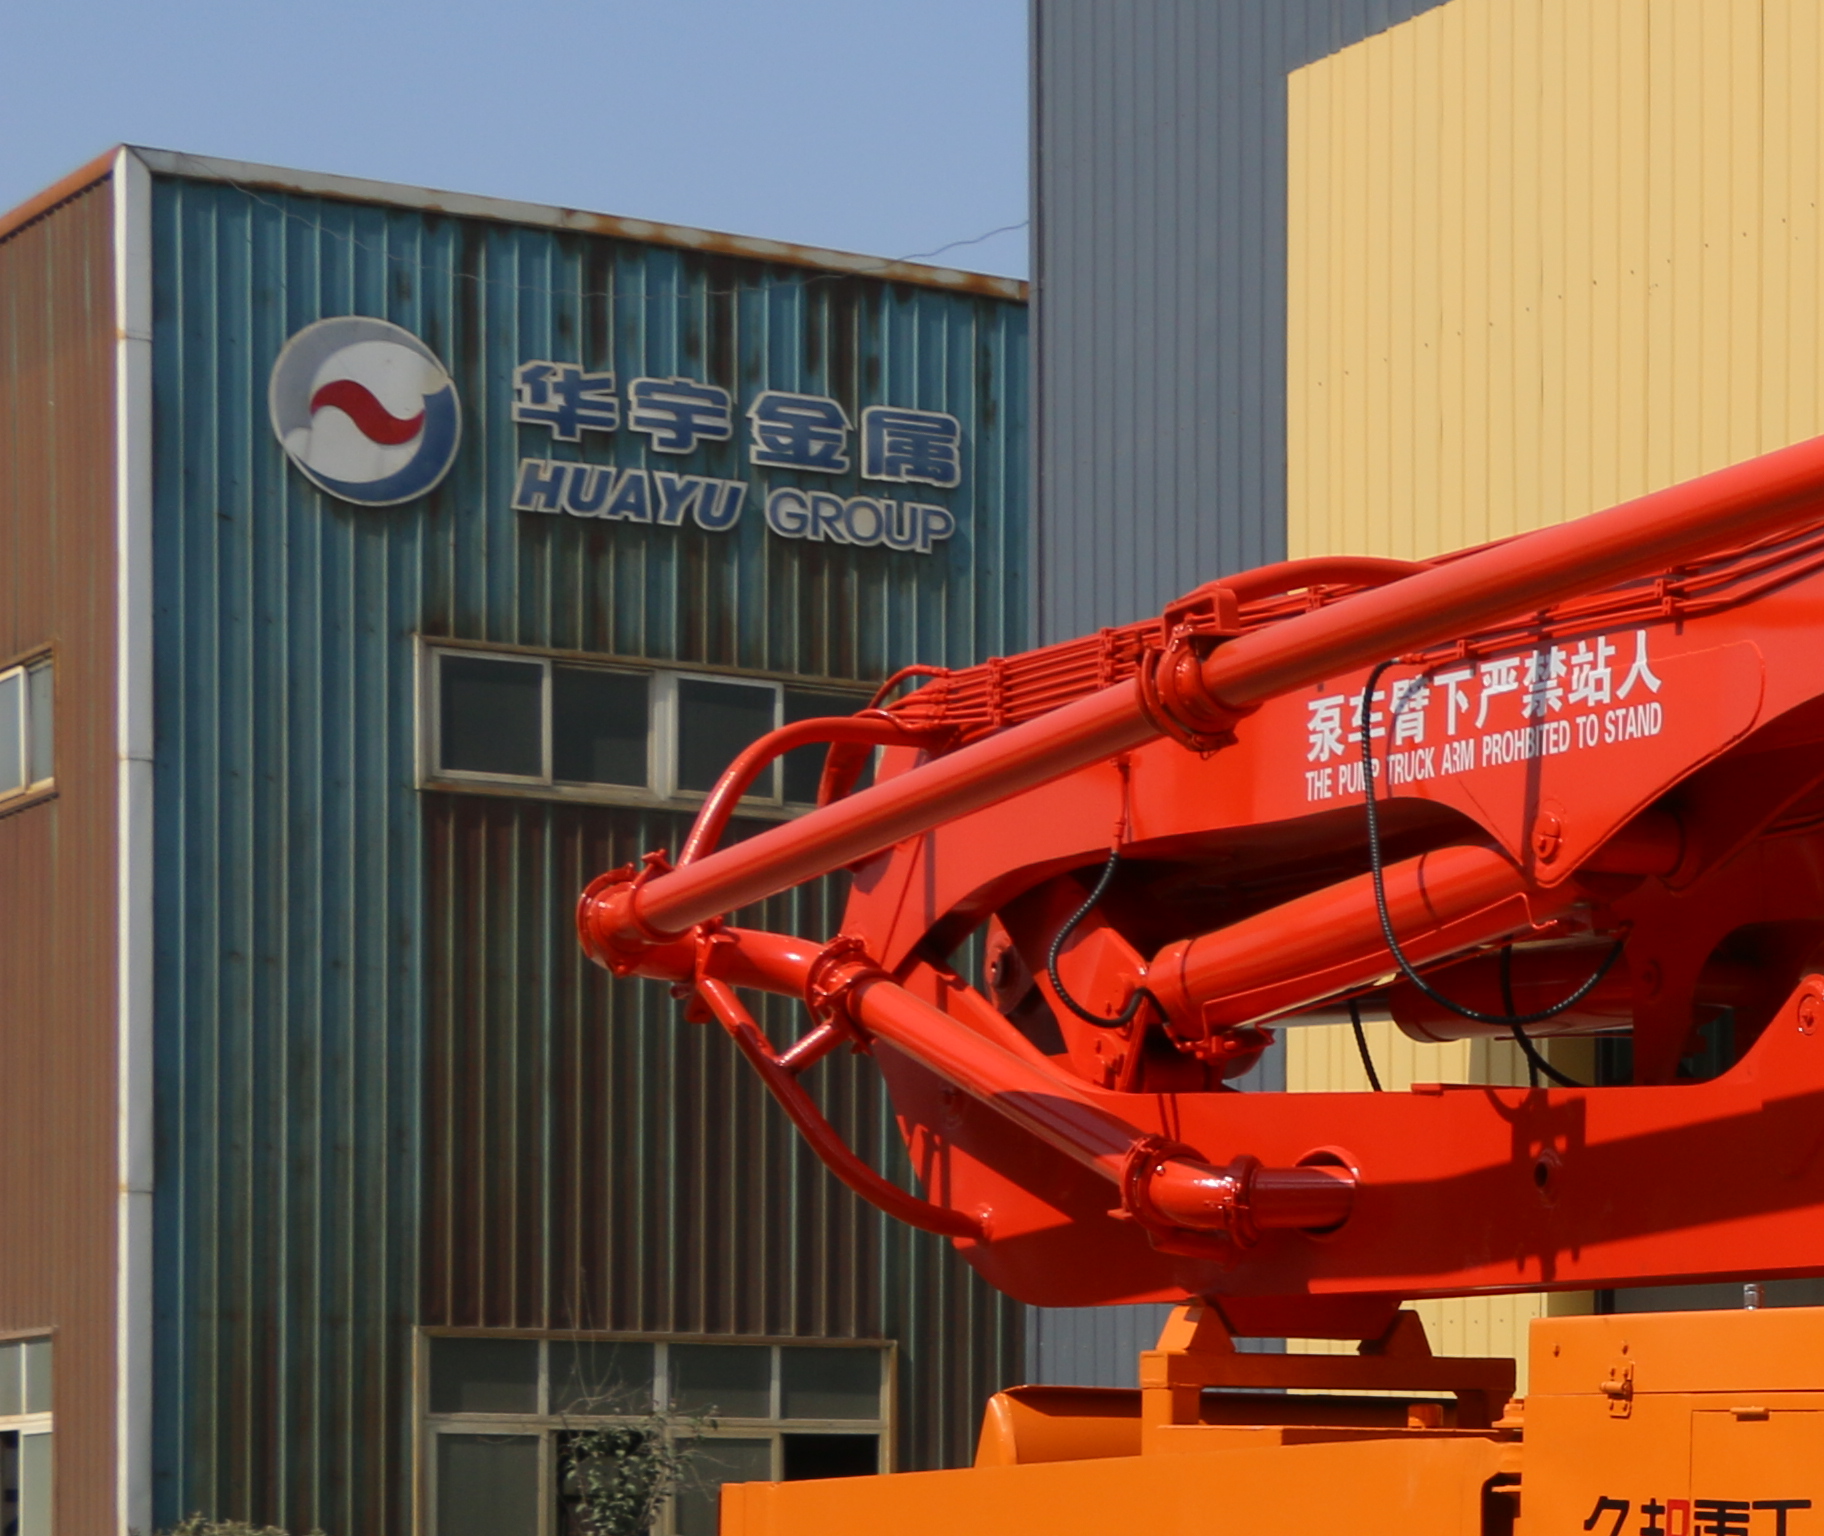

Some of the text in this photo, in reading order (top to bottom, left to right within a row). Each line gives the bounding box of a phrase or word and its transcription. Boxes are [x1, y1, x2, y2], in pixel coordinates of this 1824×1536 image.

[512, 360, 961, 488] 华宇金属
[511, 458, 955, 555] HUAYU GROUP
[1305, 768, 1332, 801] THE
[1387, 747, 1435, 785] TRUCK
[1441, 738, 1475, 776] ARM
[1575, 714, 1599, 748] TO
[1604, 702, 1662, 743] STAND
[1307, 629, 1662, 763] 泵车臂下严禁站人
